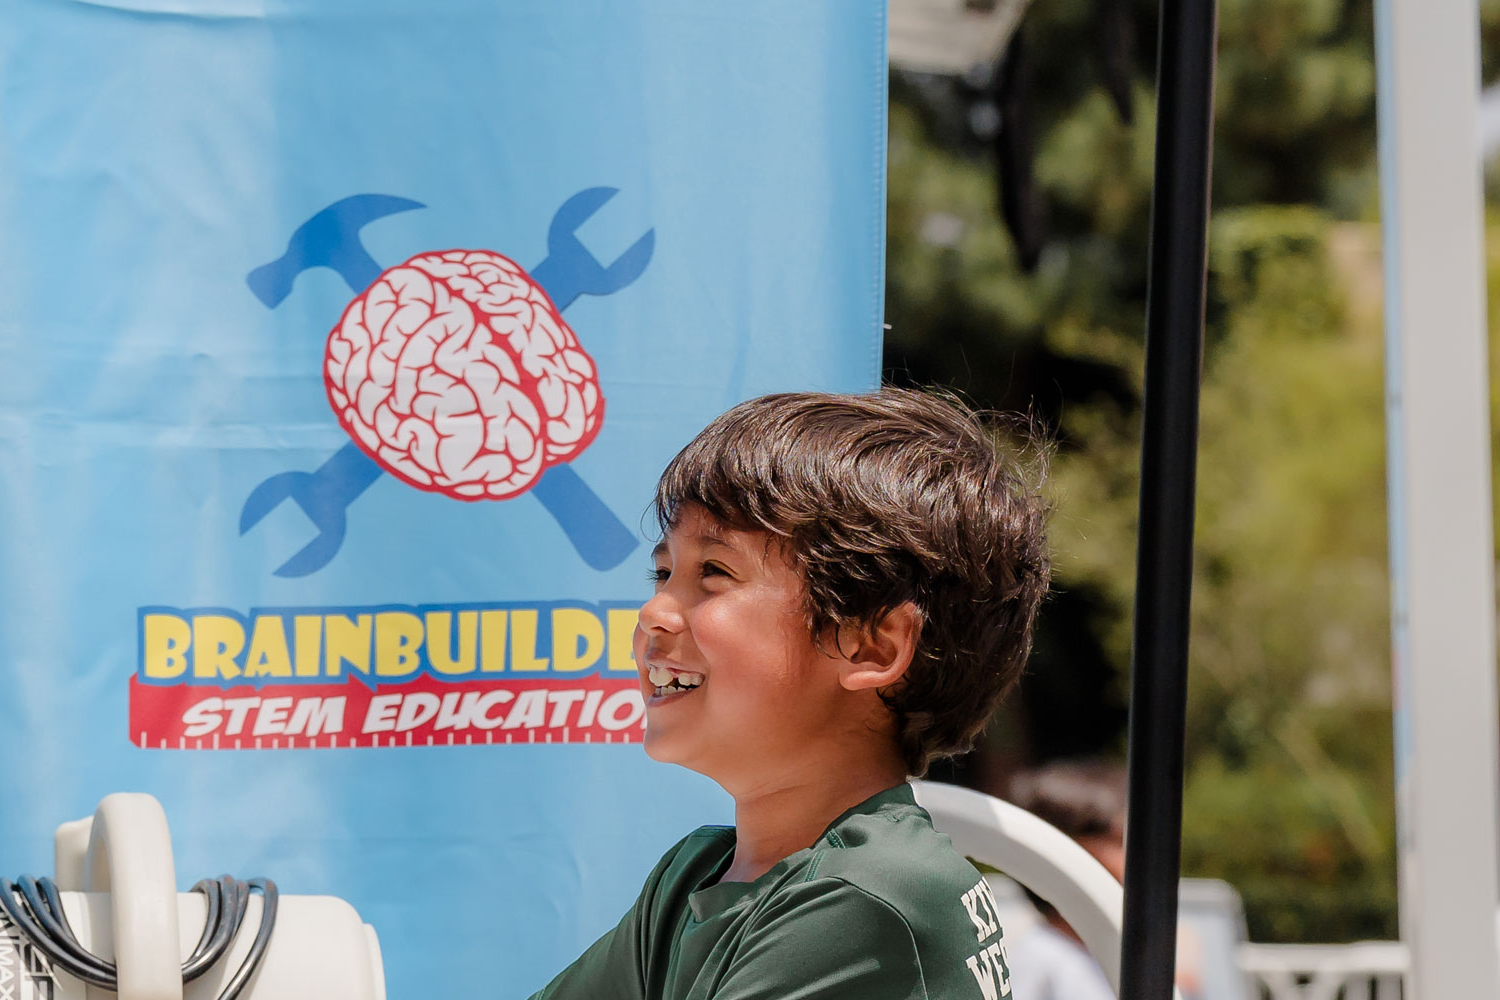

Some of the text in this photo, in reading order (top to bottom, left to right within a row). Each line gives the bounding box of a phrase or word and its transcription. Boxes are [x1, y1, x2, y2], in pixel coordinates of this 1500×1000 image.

[143, 608, 640, 680] BRAINBUILDE
[182, 689, 647, 738] STEM EDUCATIO
